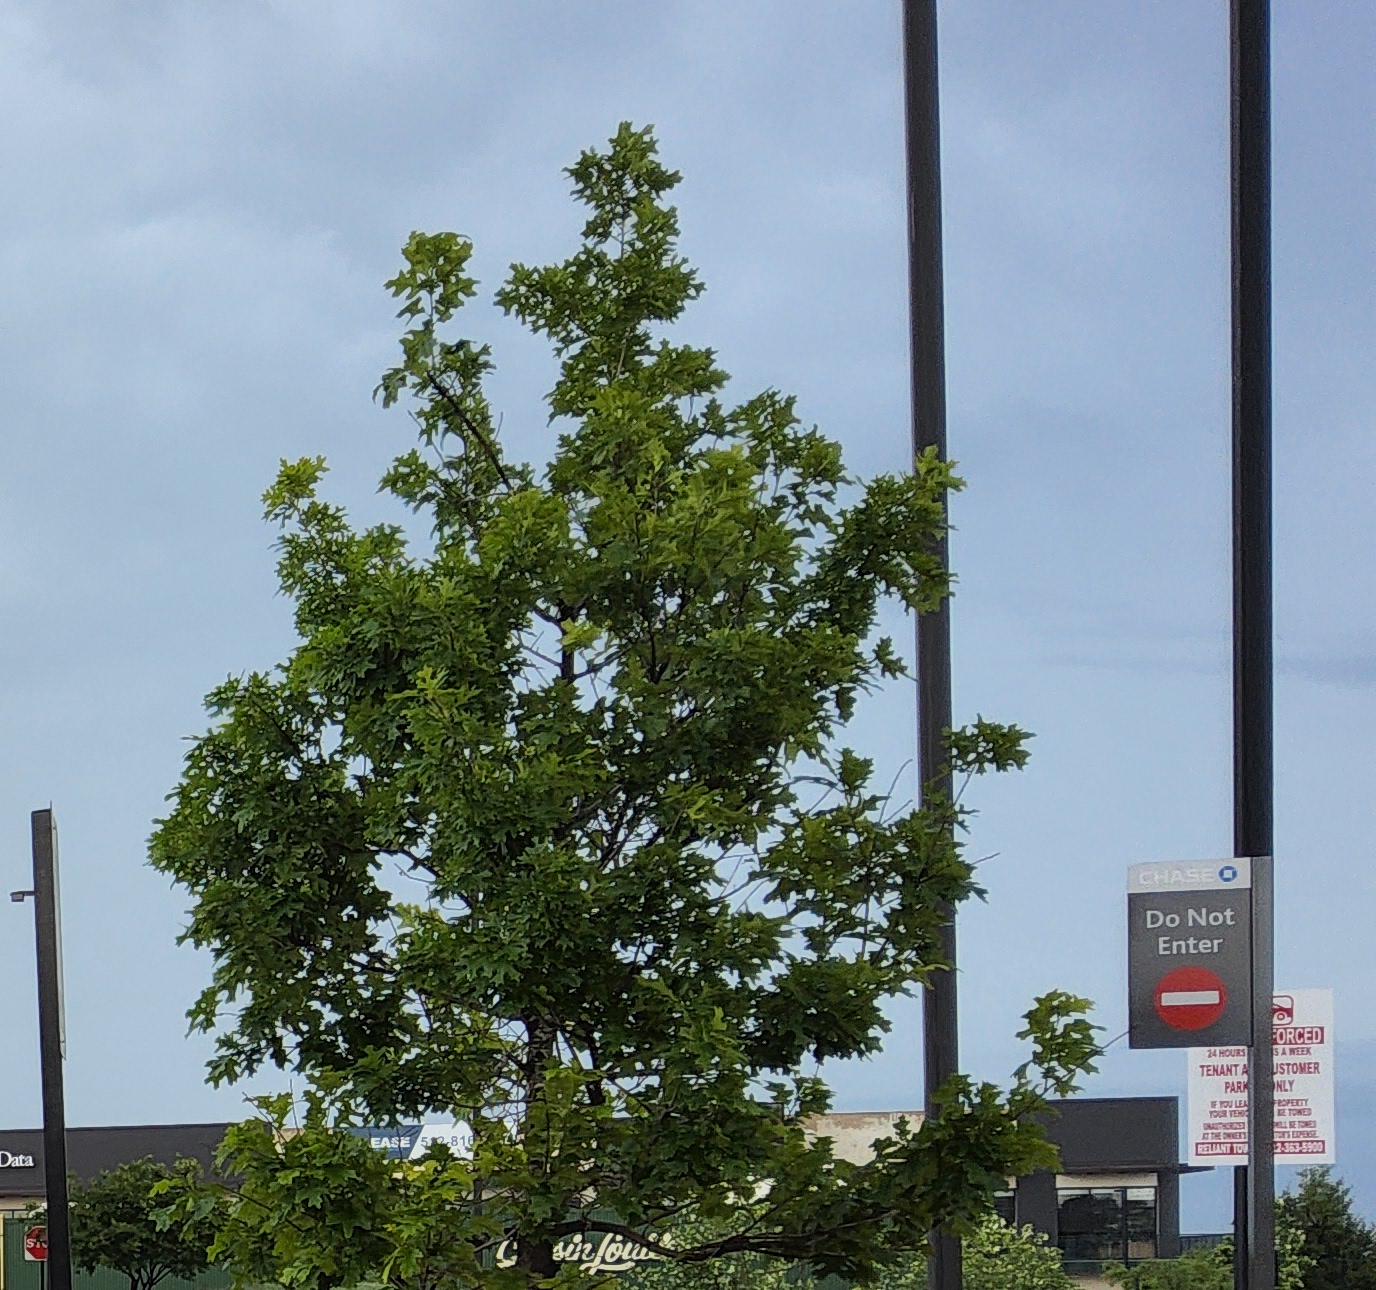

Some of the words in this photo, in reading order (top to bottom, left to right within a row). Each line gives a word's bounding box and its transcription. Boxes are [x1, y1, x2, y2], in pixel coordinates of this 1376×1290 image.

[1139, 866, 1215, 885] CHASE
[1146, 910, 1181, 929] Do
[1188, 907, 1236, 927] Not
[1158, 936, 1224, 955] Enter
[1199, 1064, 1240, 1077] TENANT
[1273, 1062, 1320, 1075] USTOMER
[1224, 1081, 1248, 1093] PARK
[370, 1136, 411, 1149] EASE
